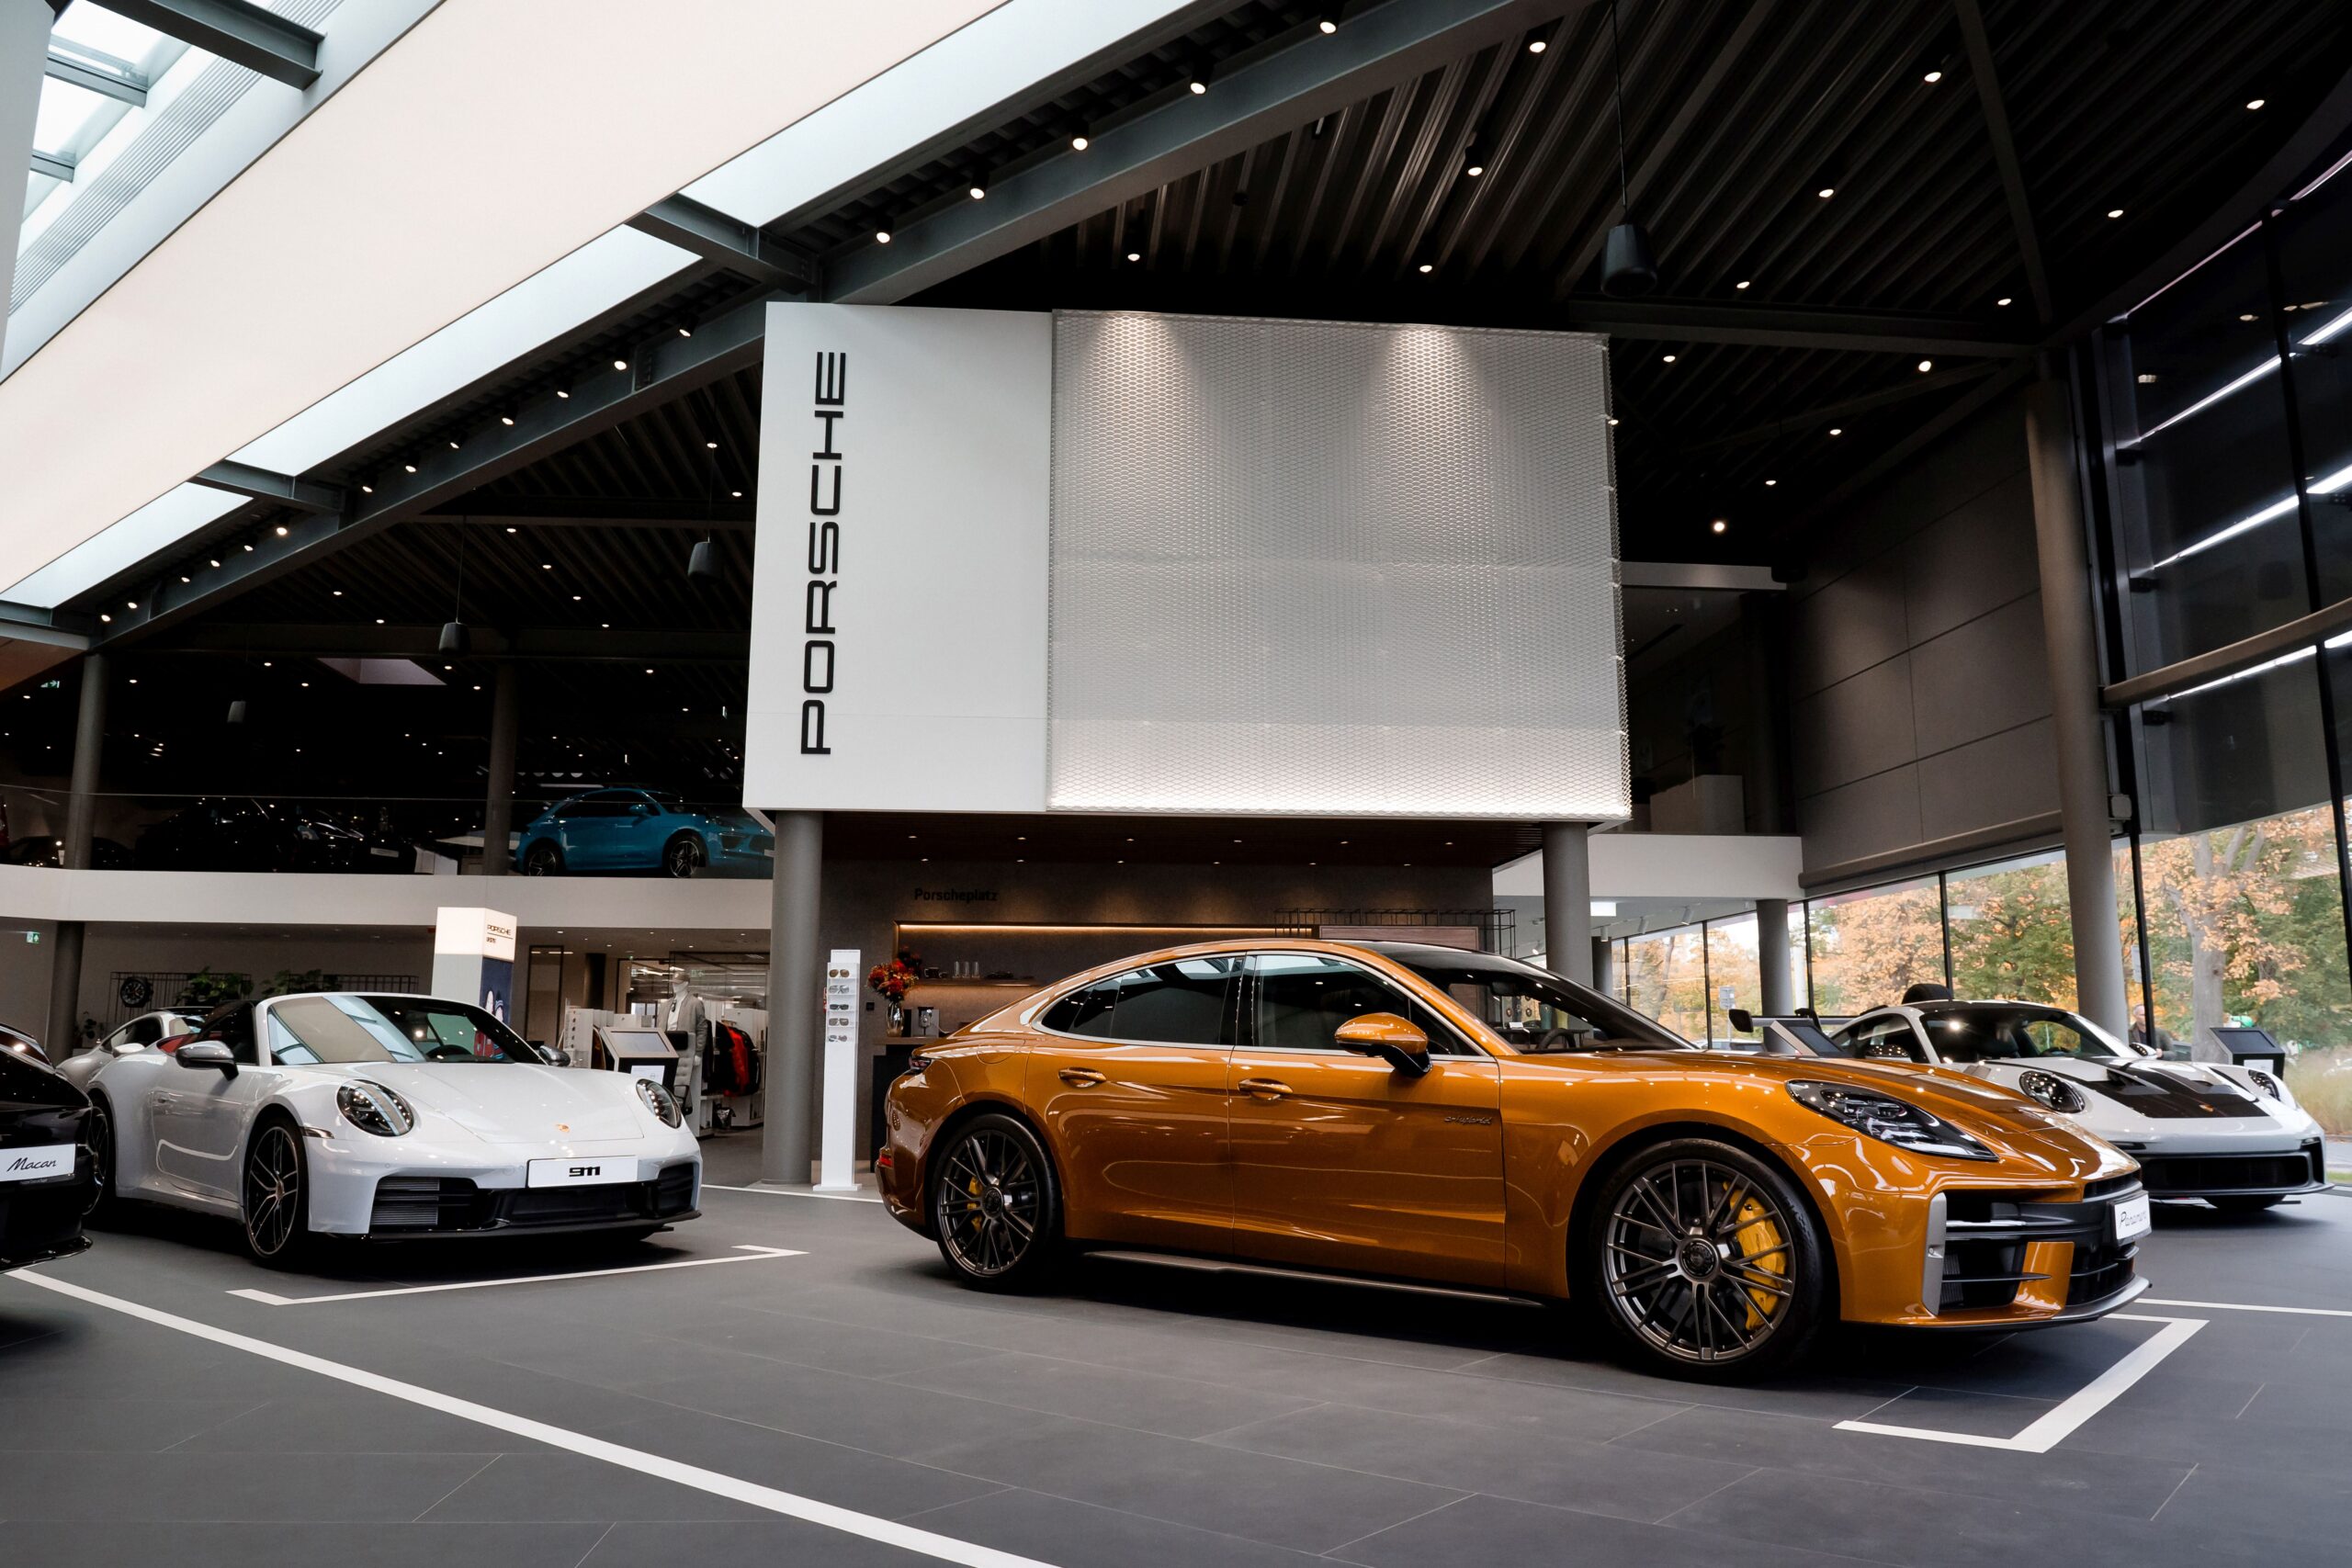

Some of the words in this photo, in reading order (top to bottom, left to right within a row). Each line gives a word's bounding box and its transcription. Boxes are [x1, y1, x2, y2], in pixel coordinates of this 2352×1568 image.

[801, 352, 846, 754] PORSCHE
[914, 887, 998, 904] Porscheplatz
[6, 1157, 57, 1172] Macan
[569, 1166, 601, 1178] 911
